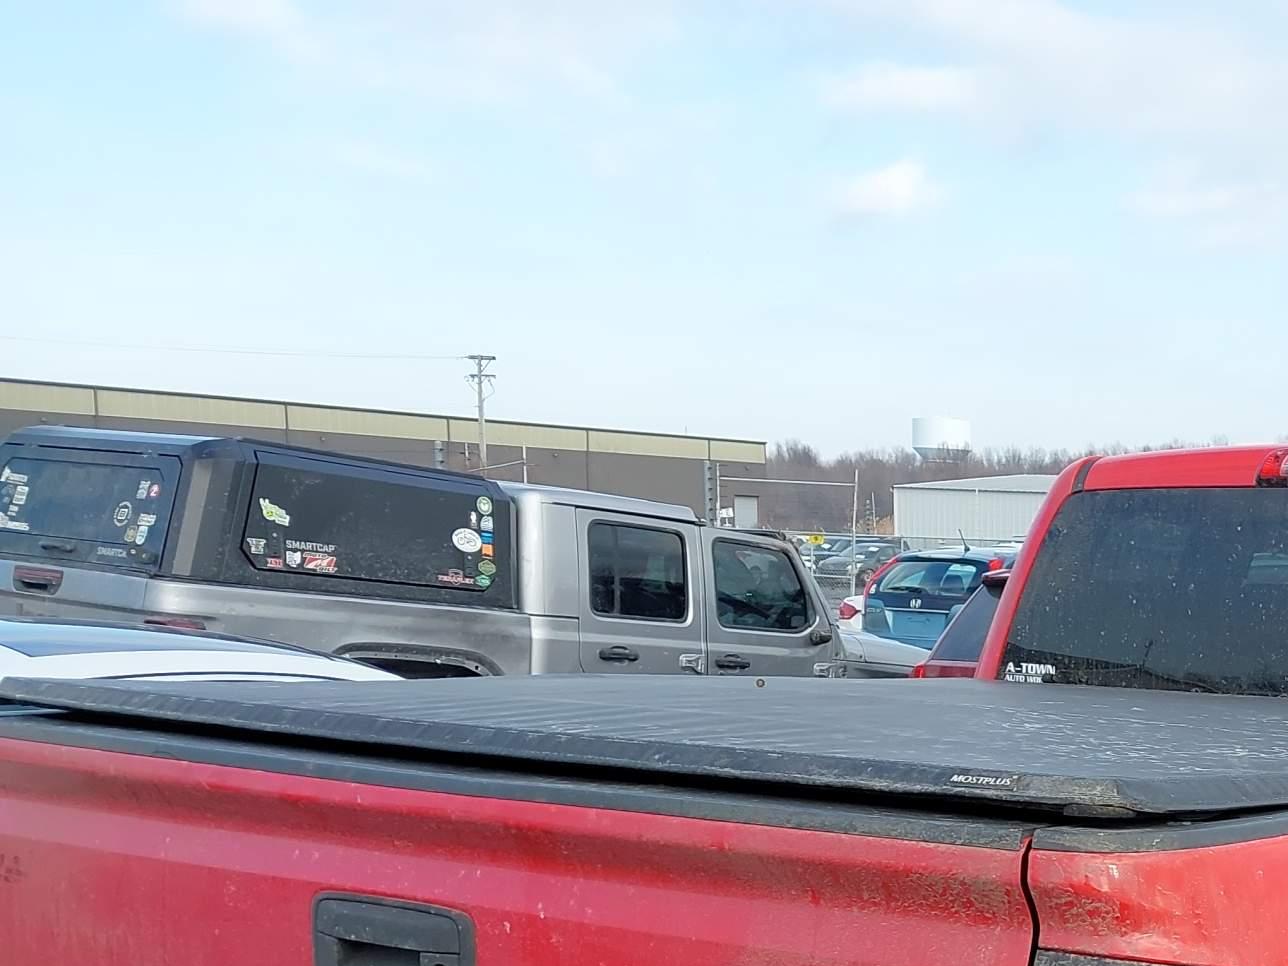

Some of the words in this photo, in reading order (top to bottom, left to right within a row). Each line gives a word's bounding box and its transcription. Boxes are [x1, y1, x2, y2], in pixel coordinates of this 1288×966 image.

[285, 539, 336, 553] SMARTCAP
[1005, 661, 1056, 675] A-TOWN
[1004, 674, 1025, 683] AUTO
[950, 774, 1013, 786] MOSTPLUS
